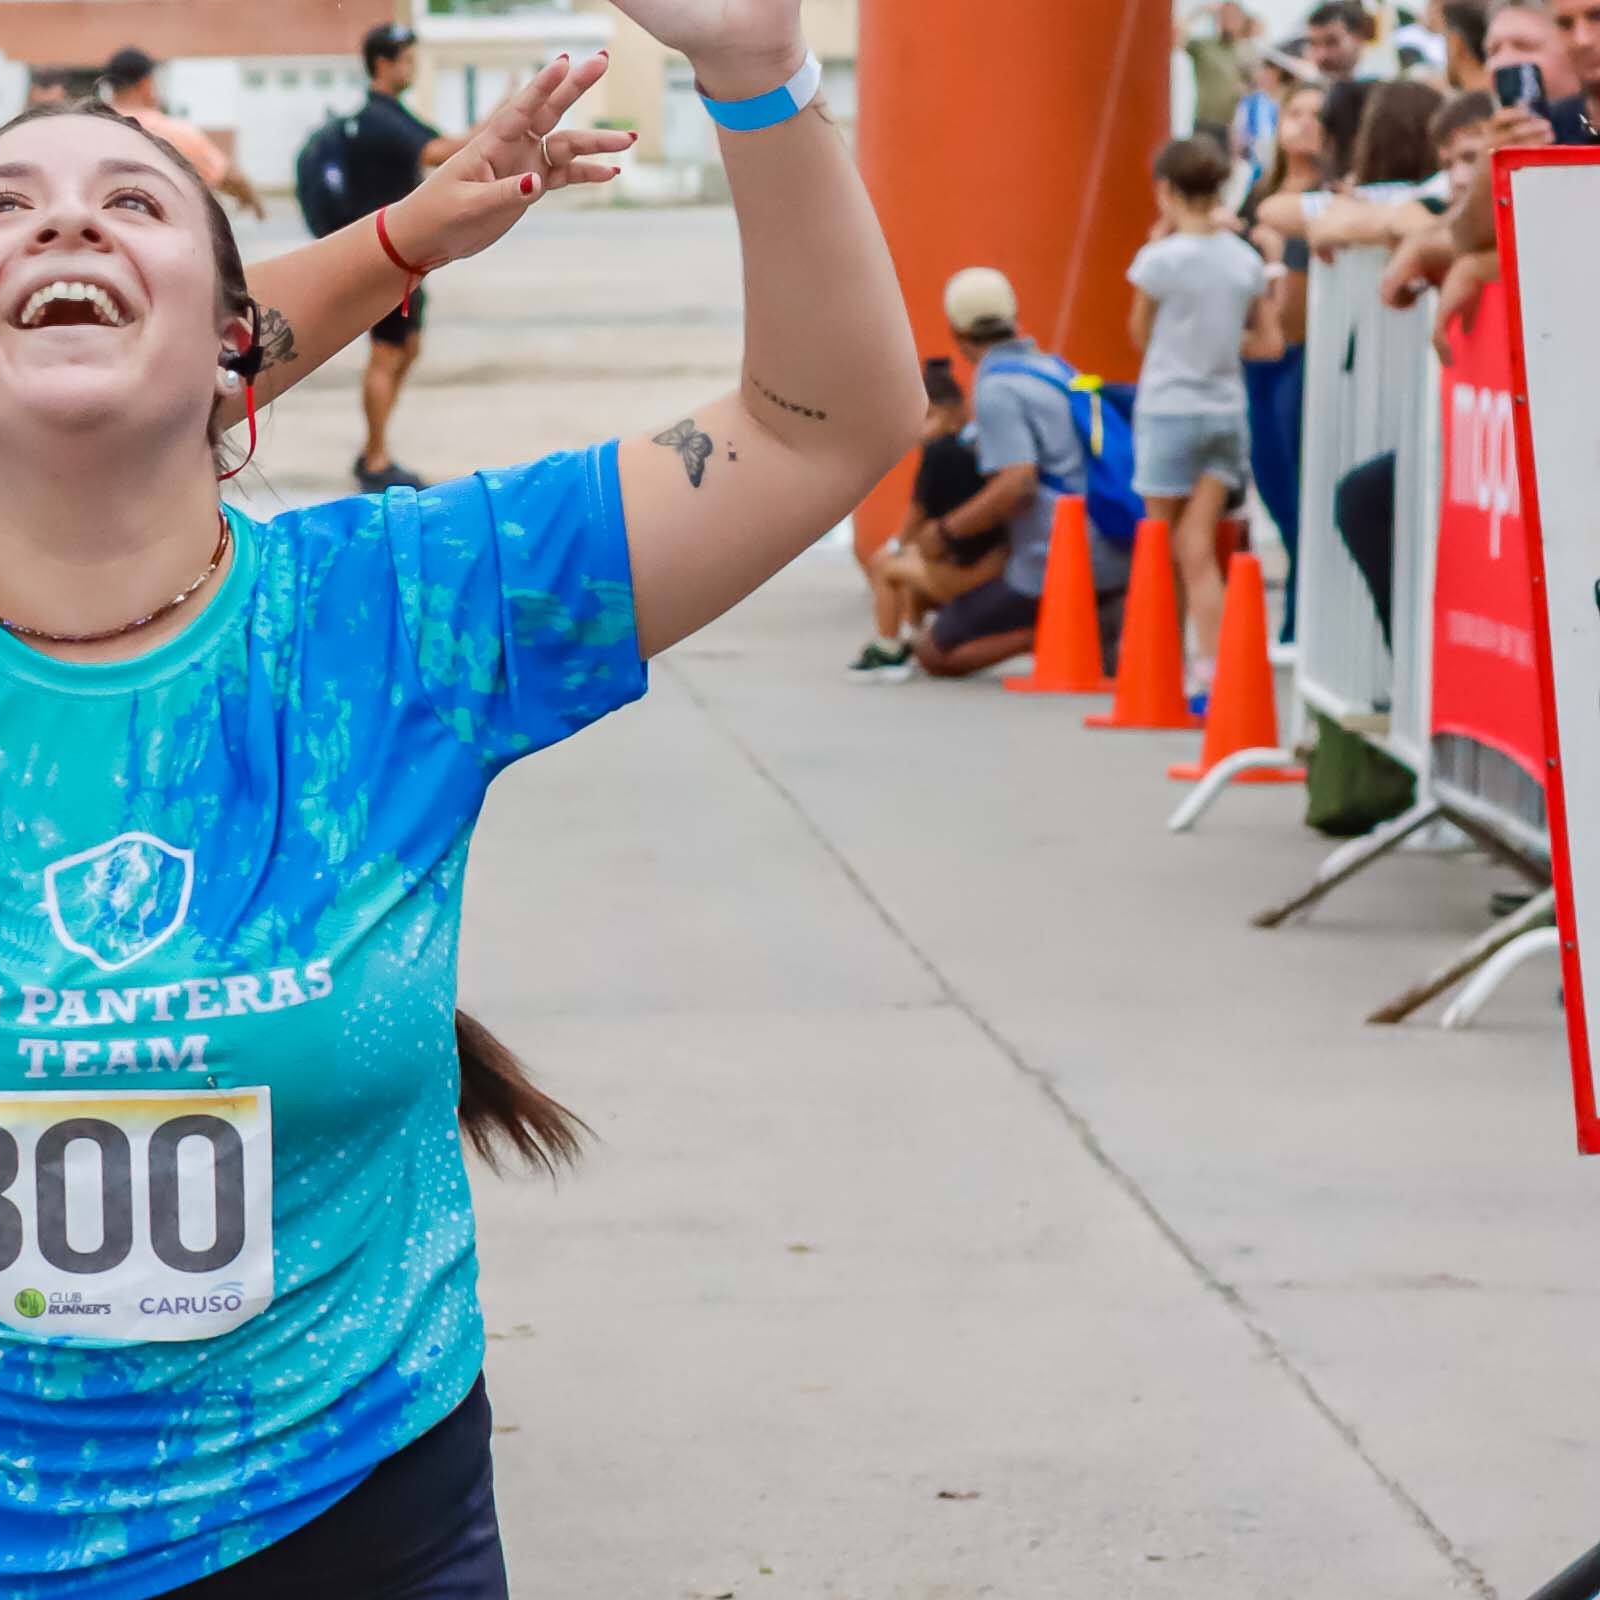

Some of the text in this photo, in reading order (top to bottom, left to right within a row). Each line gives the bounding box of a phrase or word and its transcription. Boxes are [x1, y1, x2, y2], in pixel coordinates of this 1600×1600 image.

[17, 958, 334, 1026] PANTERAS
[18, 1034, 210, 1078] TEAM
[50, 1292, 82, 1304] CLUB
[139, 1294, 242, 1315] CARUSO
[48, 1303, 112, 1315] RUNNER'S
